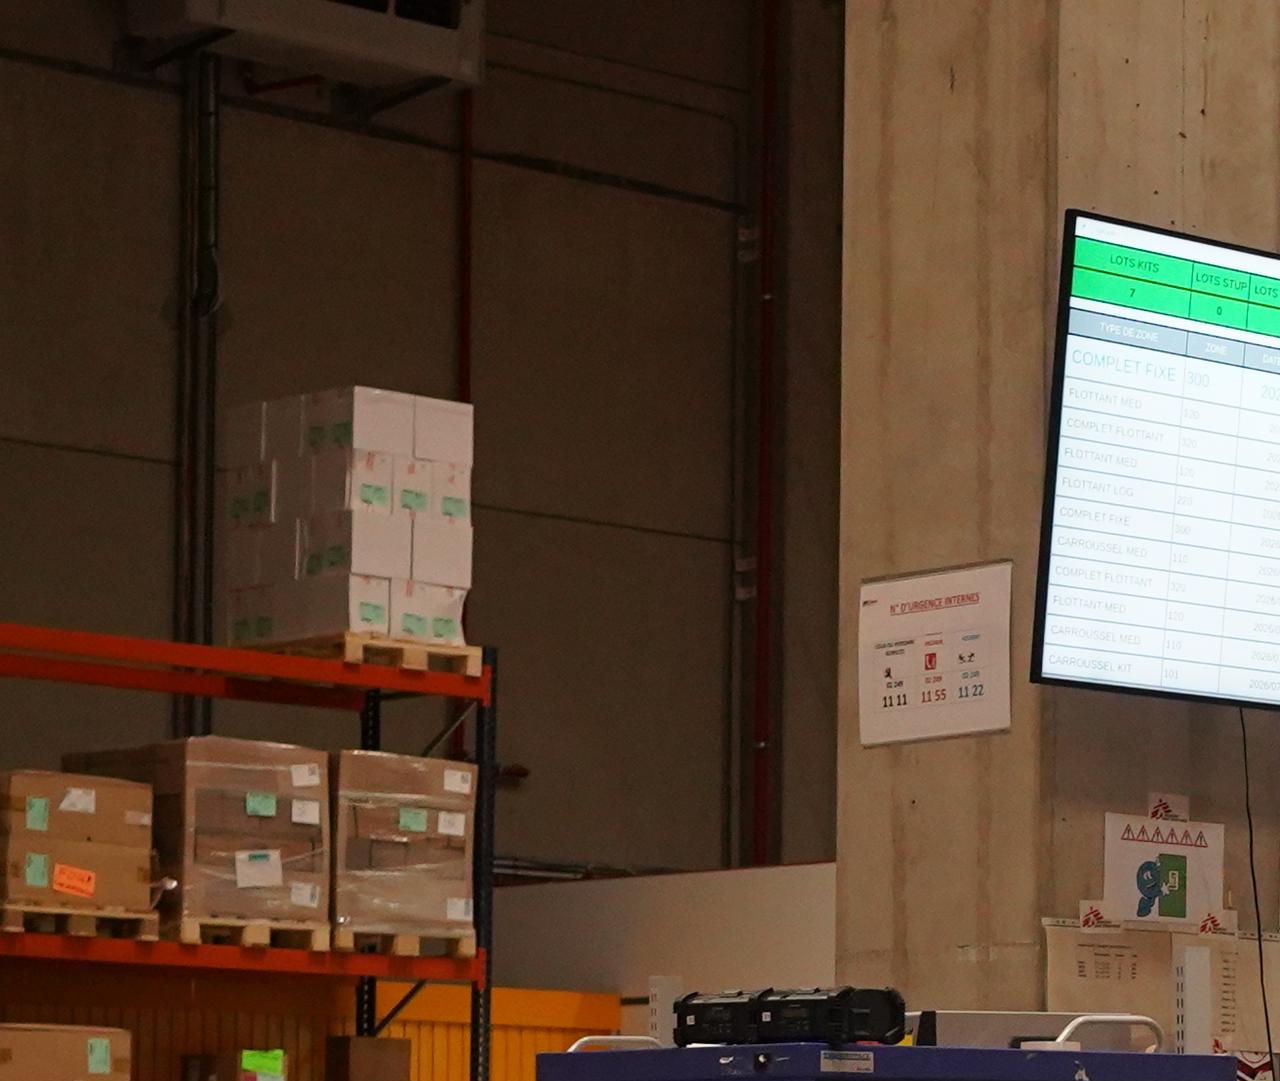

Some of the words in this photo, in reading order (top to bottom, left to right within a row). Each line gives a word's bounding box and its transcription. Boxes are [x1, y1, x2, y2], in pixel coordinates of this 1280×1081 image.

[1109, 253, 1135, 269] LOTS
[1136, 259, 1160, 274] KITS
[1195, 271, 1220, 287] LOTS
[1222, 277, 1247, 292] STUP
[1253, 283, 1278, 299] LOTS
[1071, 348, 1140, 376] COMPLET
[1144, 362, 1177, 382] FIXE
[921, 690, 932, 703] 11
[958, 686, 969, 699] 11
[972, 684, 984, 697] 22
[882, 695, 894, 707] 11
[896, 693, 908, 706] 11
